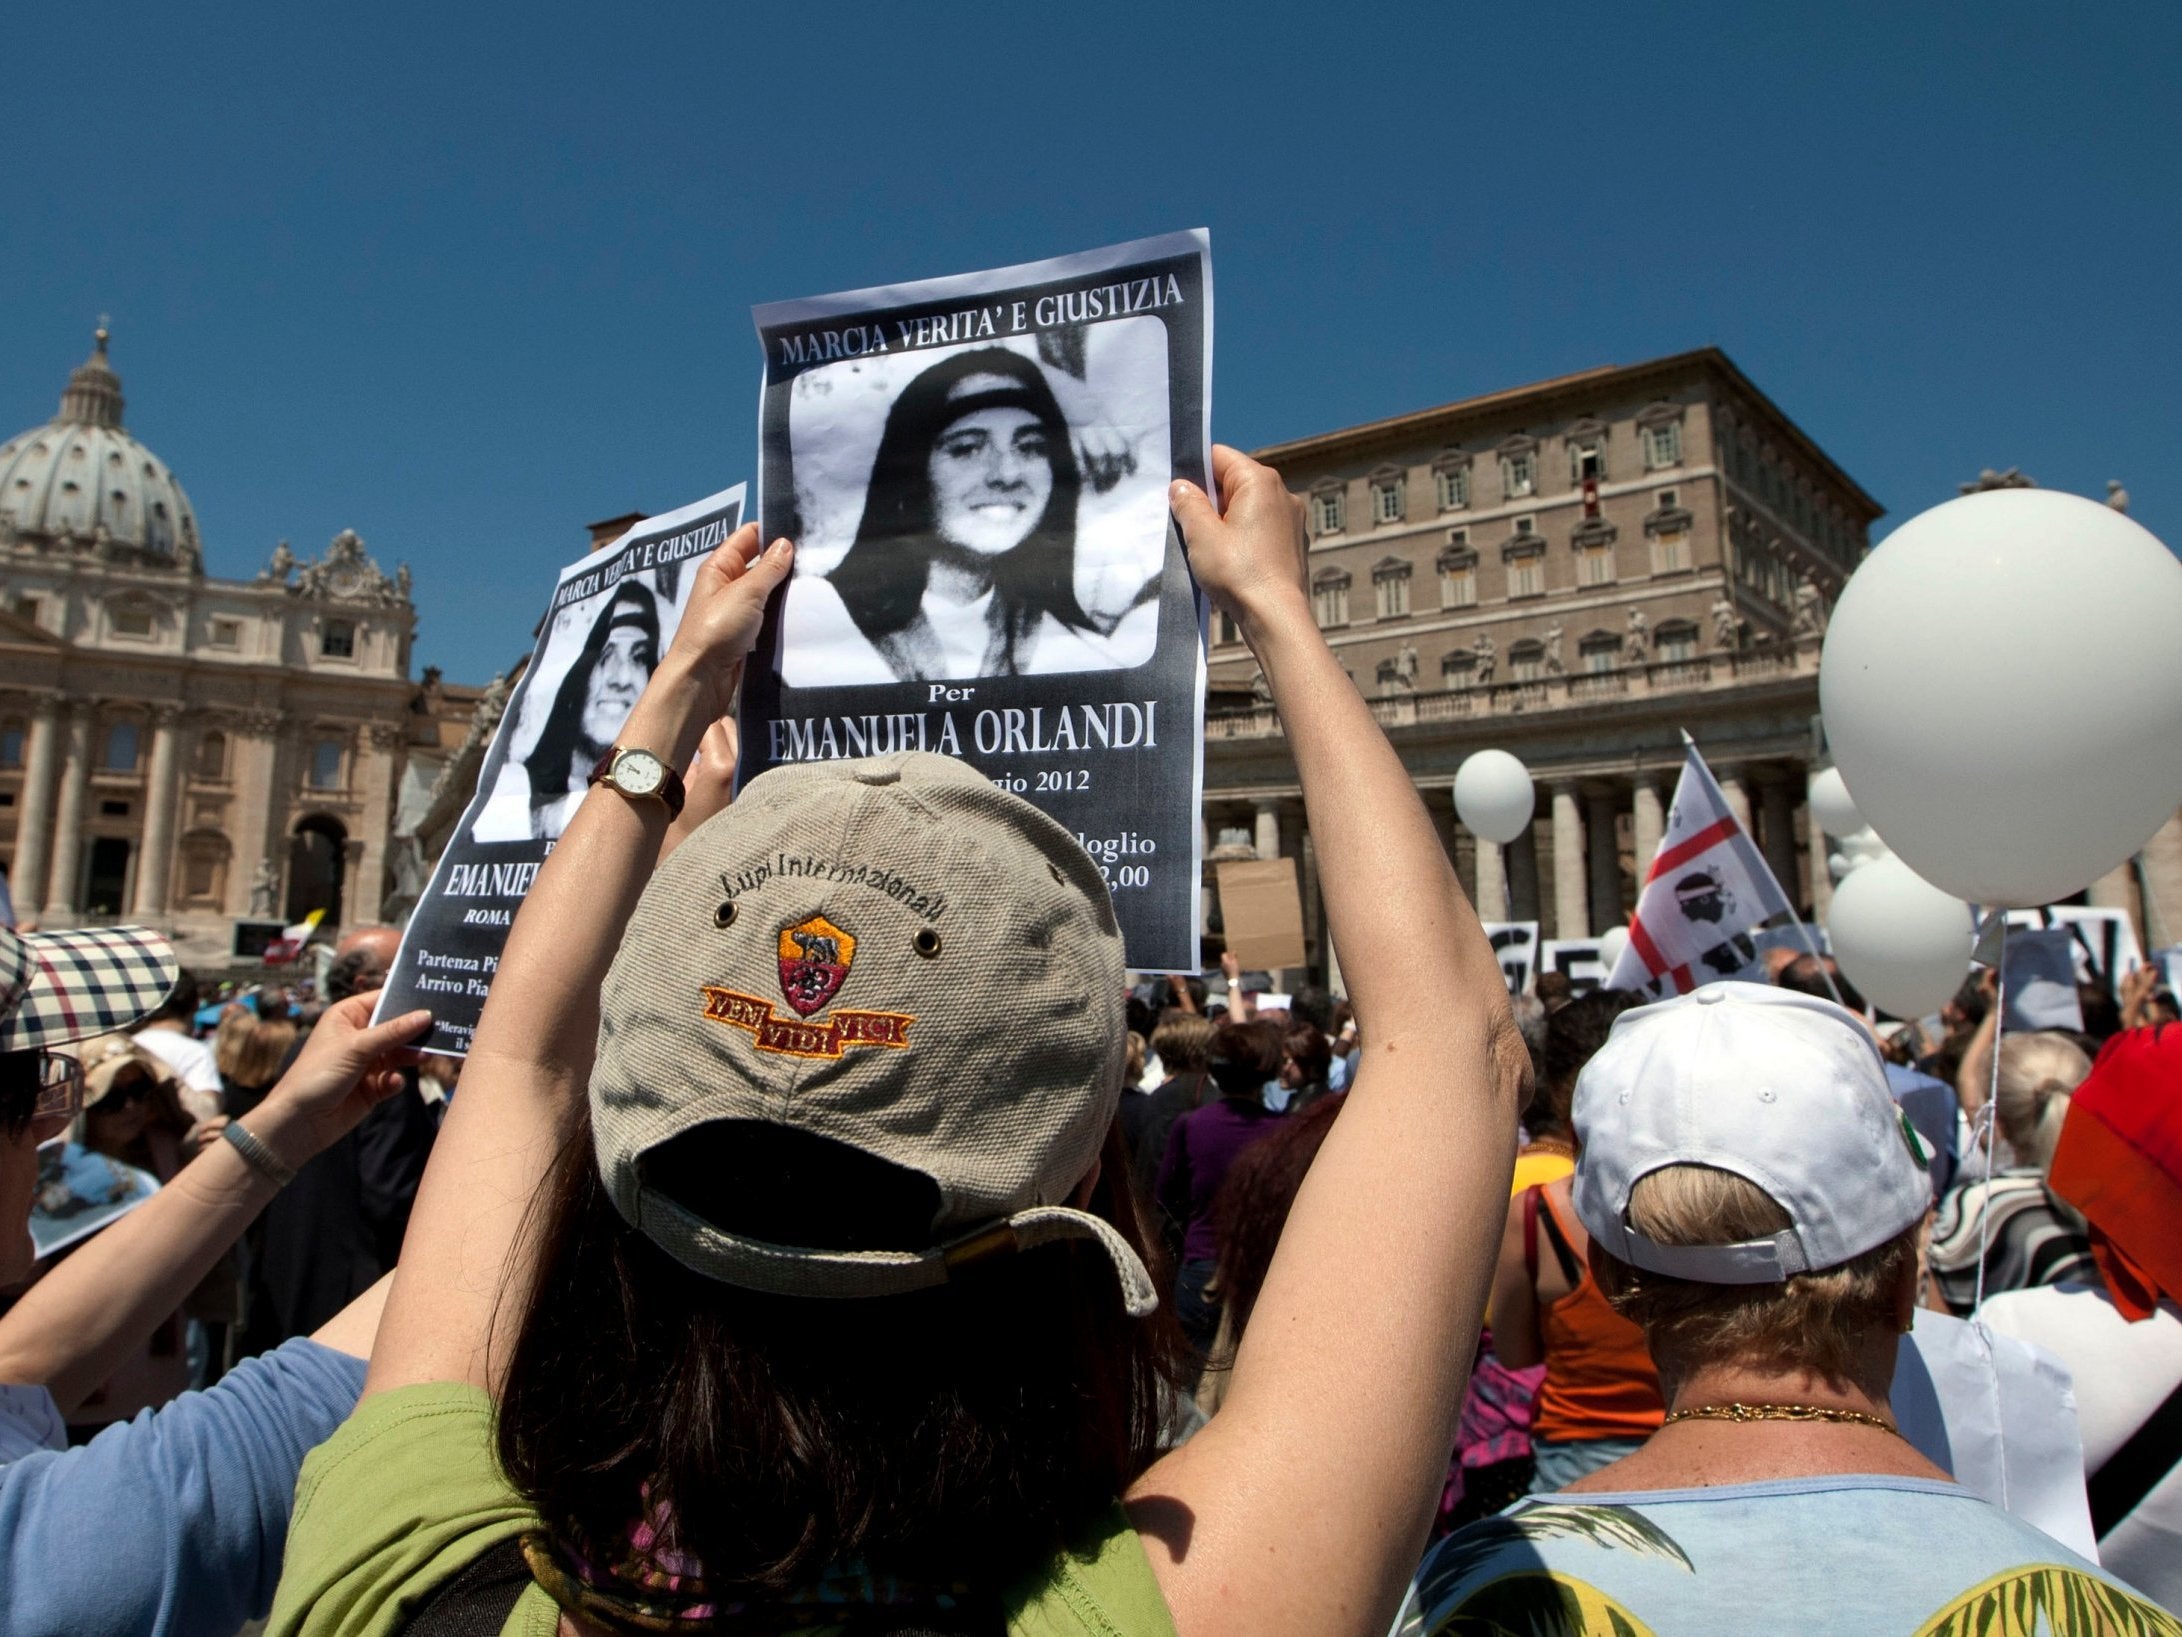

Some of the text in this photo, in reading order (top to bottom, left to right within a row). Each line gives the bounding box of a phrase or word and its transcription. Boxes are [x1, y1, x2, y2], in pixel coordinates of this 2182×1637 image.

[779, 272, 1184, 365] MARCIA VERITA’ E GIUSTIZIA
[556, 571, 600, 608] MARCIA
[643, 543, 655, 568] E
[657, 517, 728, 563] GIUSTIZIA
[928, 684, 975, 702] Per
[767, 701, 1158, 761] EMANUELA ORLANDI
[1035, 769, 1090, 791] 2012
[719, 858, 773, 899] Lupi
[463, 908, 512, 925] ROMA
[417, 949, 479, 971] Partenza
[415, 973, 464, 994] Arrivo
[714, 994, 768, 1029] VENI
